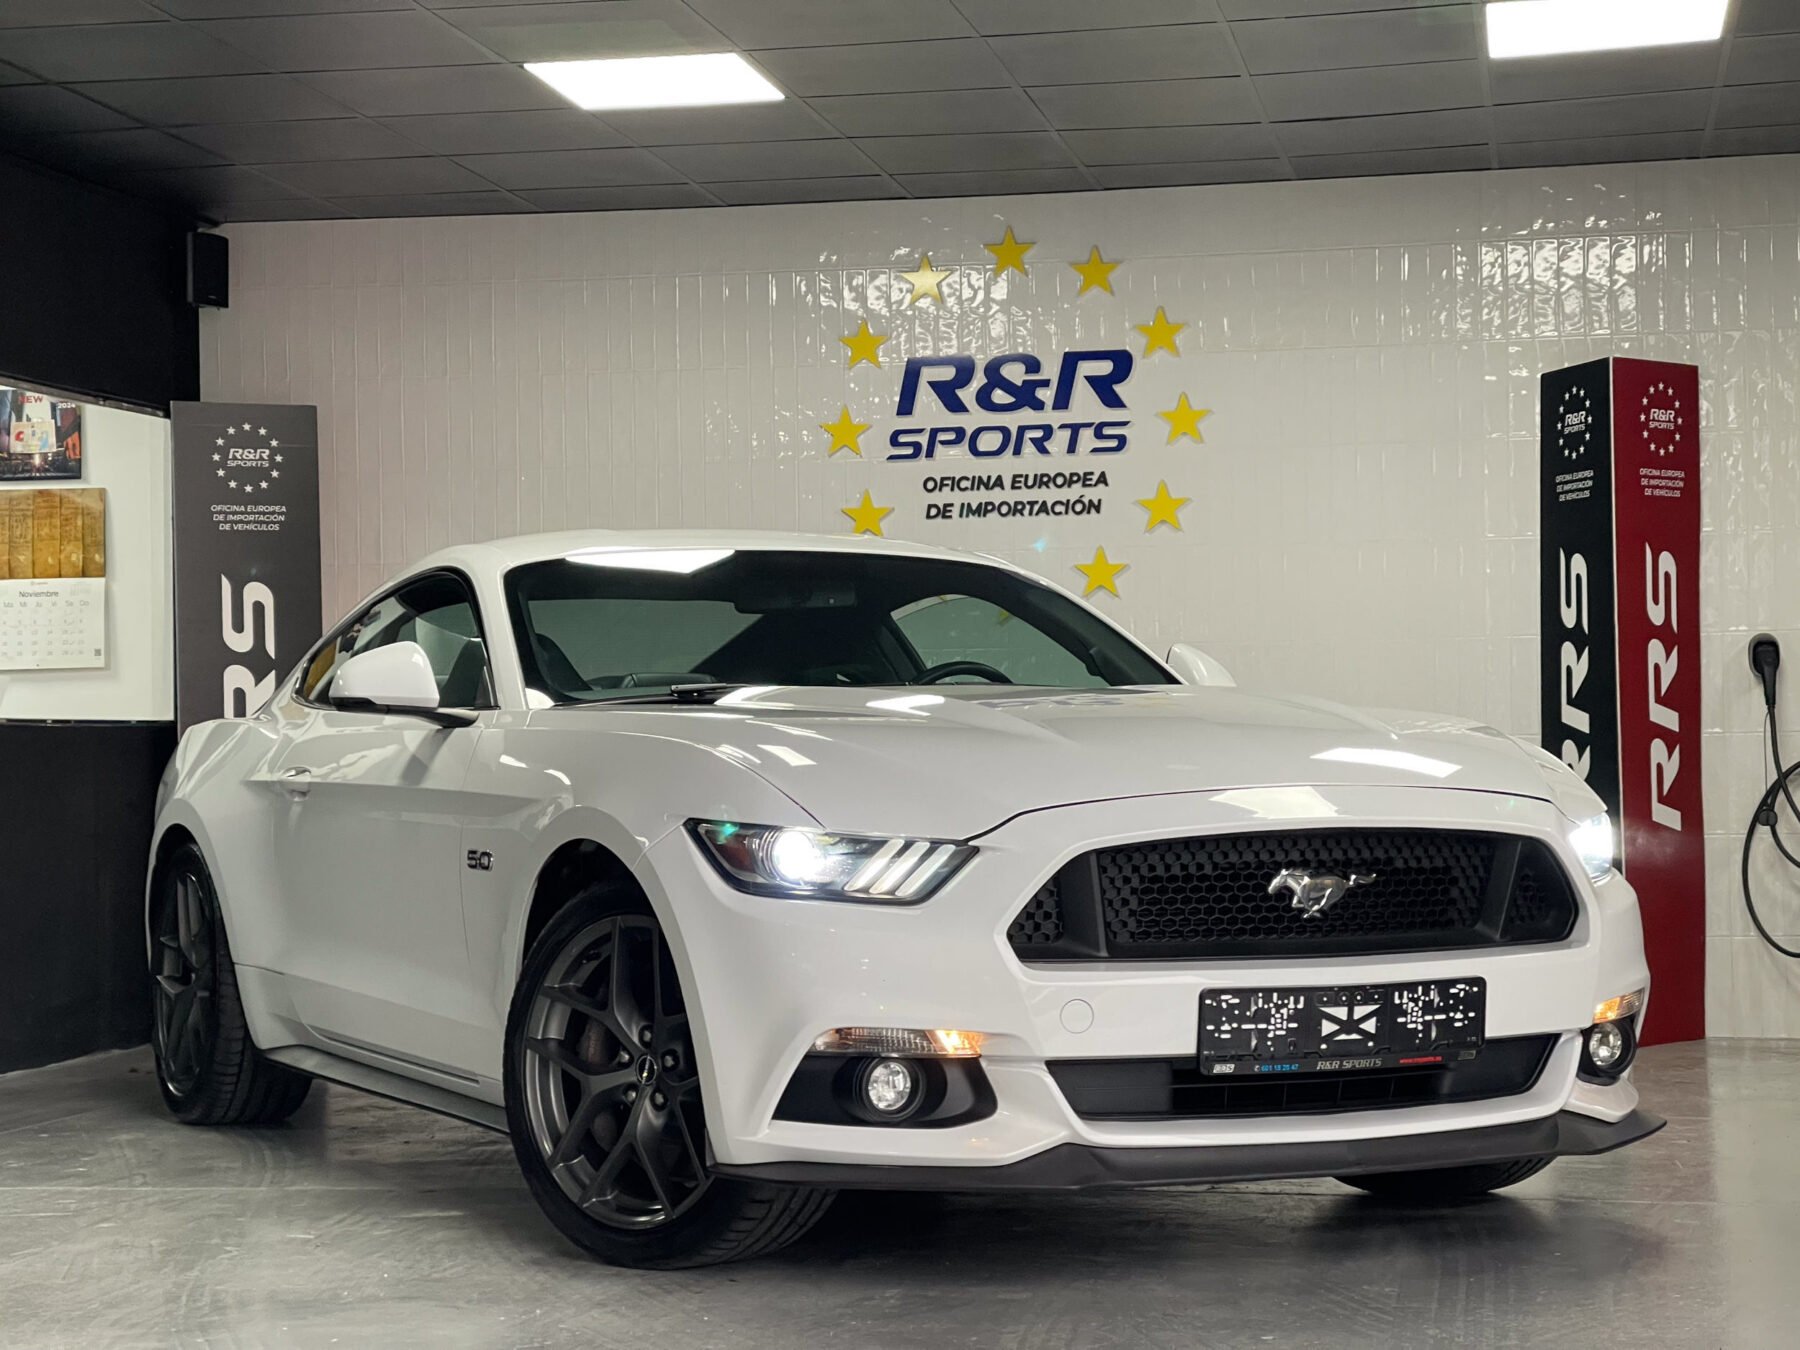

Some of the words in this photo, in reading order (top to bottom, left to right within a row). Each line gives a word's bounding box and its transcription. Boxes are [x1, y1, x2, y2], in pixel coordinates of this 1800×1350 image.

[896, 349, 1134, 416] R&R
[1564, 411, 1586, 426] R&R
[1649, 409, 1675, 422] R&R
[1564, 424, 1586, 435] SPORTS
[1649, 421, 1675, 430] SPORTS
[886, 421, 1131, 461] SPORTS
[228, 448, 270, 460] R&R
[226, 460, 270, 468] SPORTS
[922, 475, 1005, 494] OFICINA
[1010, 471, 1109, 491] EUROPEA
[210, 504, 246, 513] OFICINA
[247, 504, 287, 513] EUROPEA
[926, 502, 954, 520] DE
[958, 494, 1102, 519] IMPORTACIÓN
[213, 513, 226, 521] DE
[218, 523, 231, 531] DE
[232, 522, 280, 531] VEHÍCULOS
[1645, 541, 1682, 831] RRS
[1317, 1061, 1340, 1070] R&R
[1342, 1058, 1382, 1069] SPORTS
